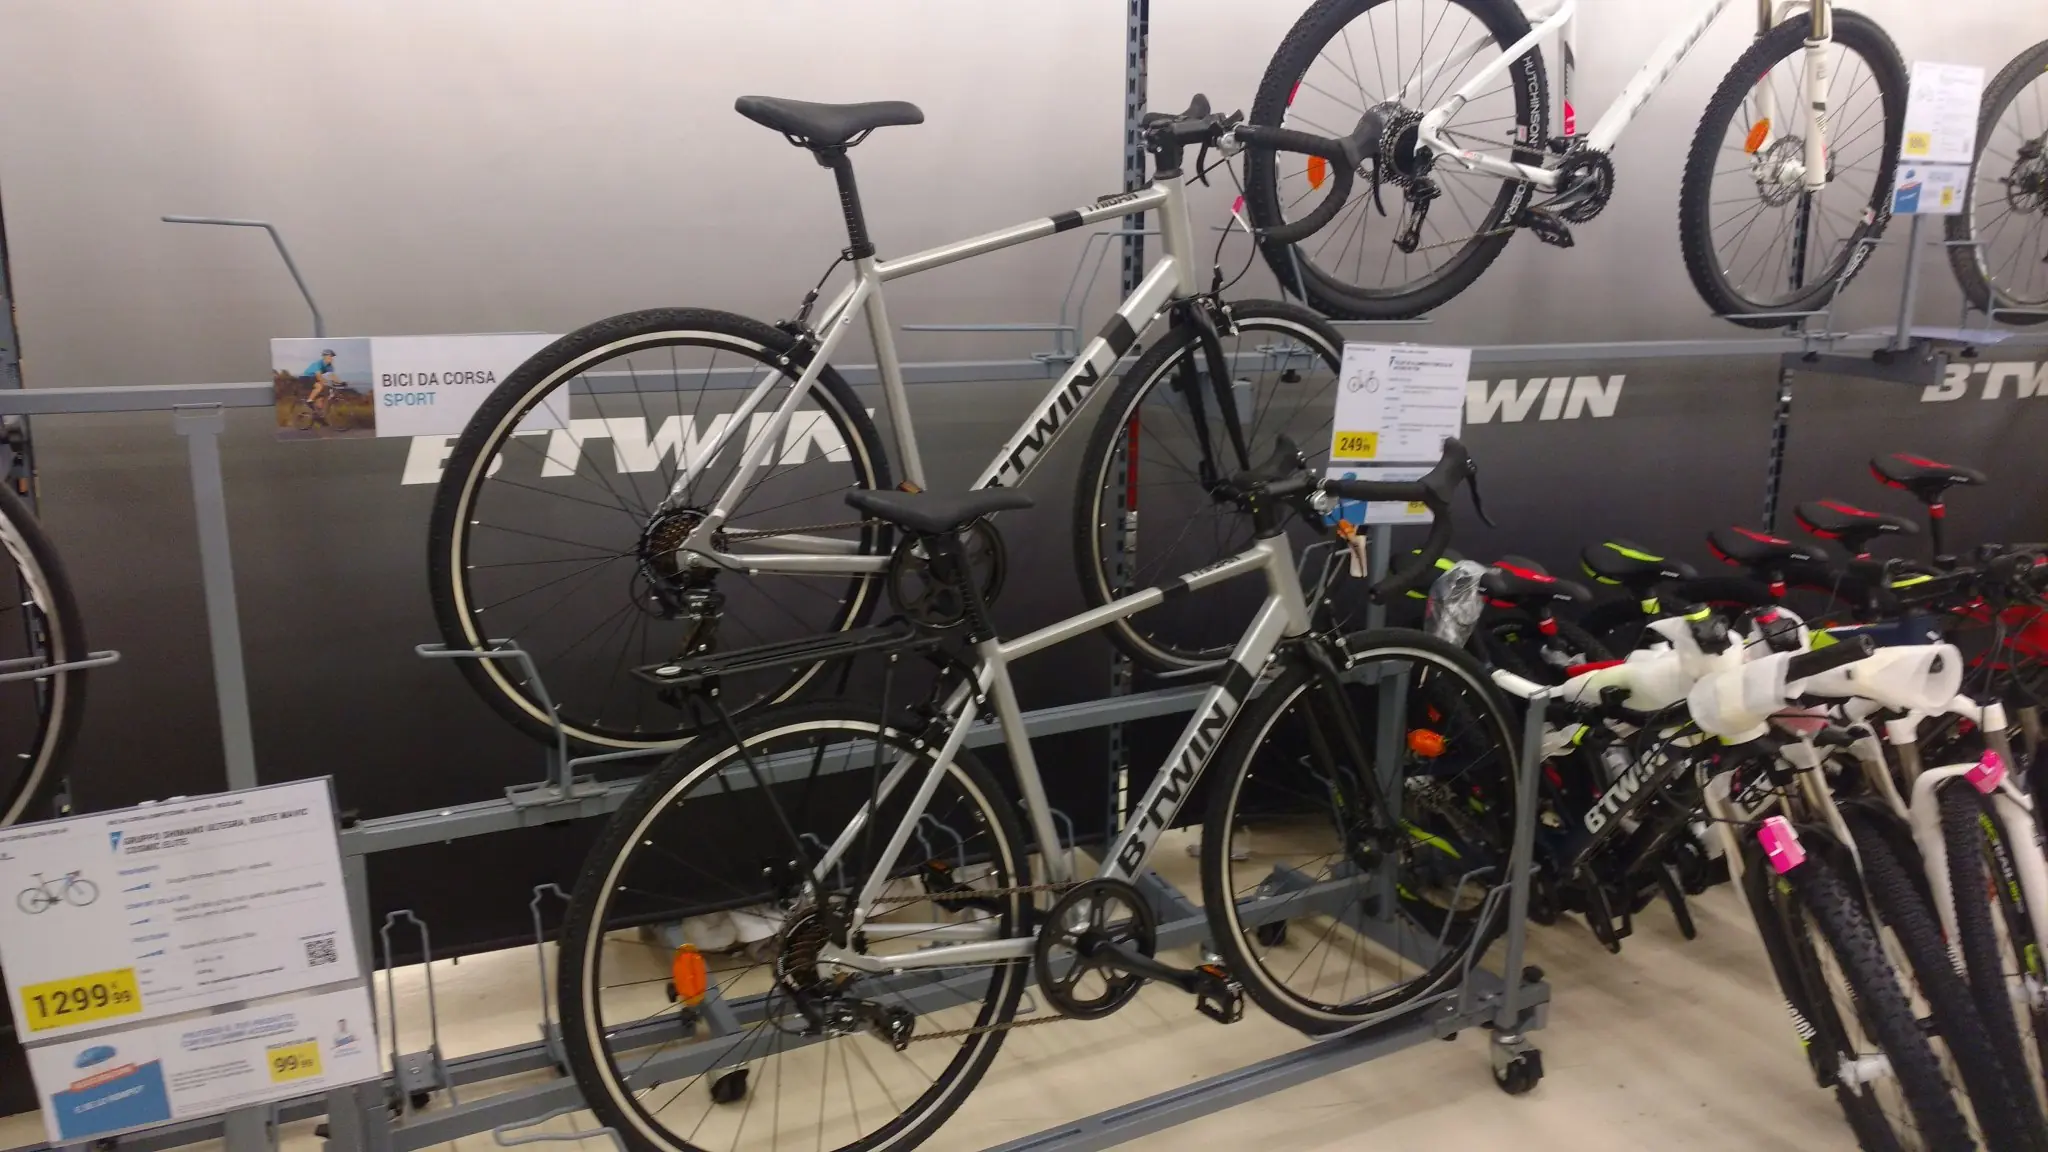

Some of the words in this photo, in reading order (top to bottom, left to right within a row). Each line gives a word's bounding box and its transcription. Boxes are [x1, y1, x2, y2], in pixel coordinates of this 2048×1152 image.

[1523, 55, 1541, 144] HUTCHINSON
[382, 372, 413, 387] BICI
[417, 372, 440, 386] DA
[443, 371, 496, 385] CORSA
[383, 392, 436, 406] SPORT
[1340, 437, 1363, 451] 249
[32, 983, 109, 1018] 1299
[273, 1054, 299, 1073] 99
